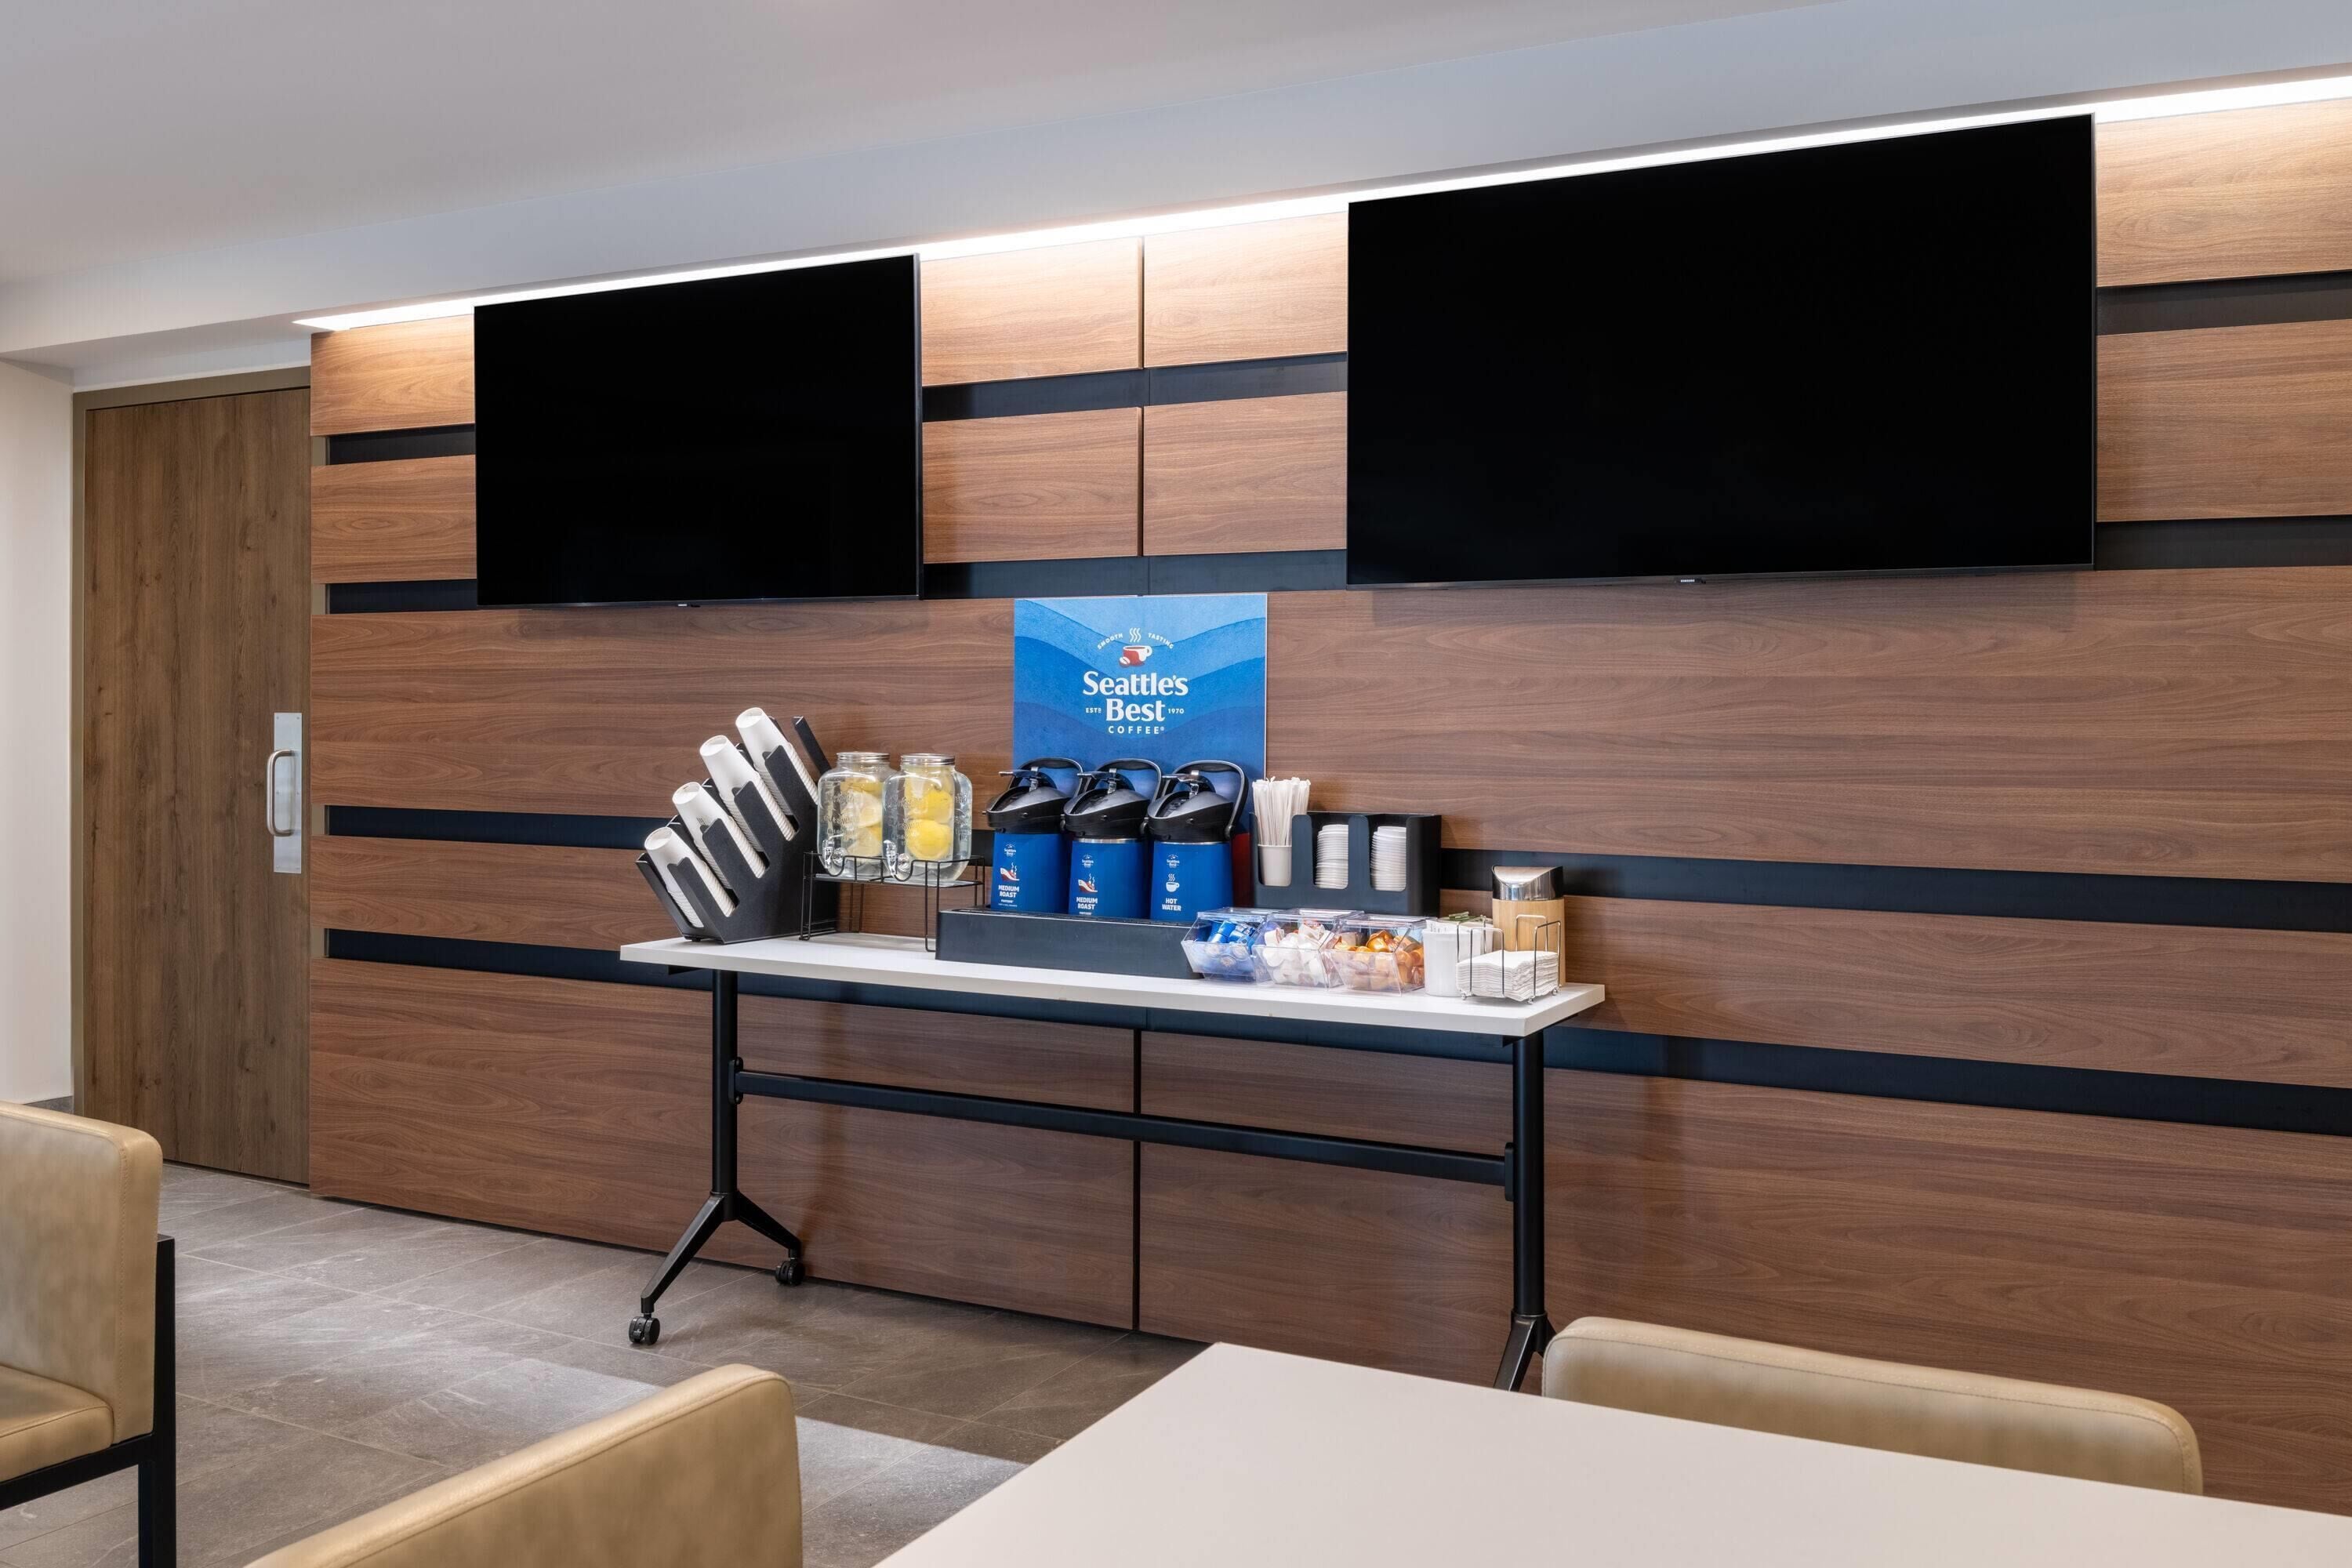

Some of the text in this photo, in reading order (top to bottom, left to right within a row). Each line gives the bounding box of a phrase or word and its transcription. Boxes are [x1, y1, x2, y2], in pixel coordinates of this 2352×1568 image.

[1098, 633, 1174, 650] SMOOTH TASTING
[1083, 670, 1189, 696] Seattle's
[1105, 698, 1167, 722] Best
